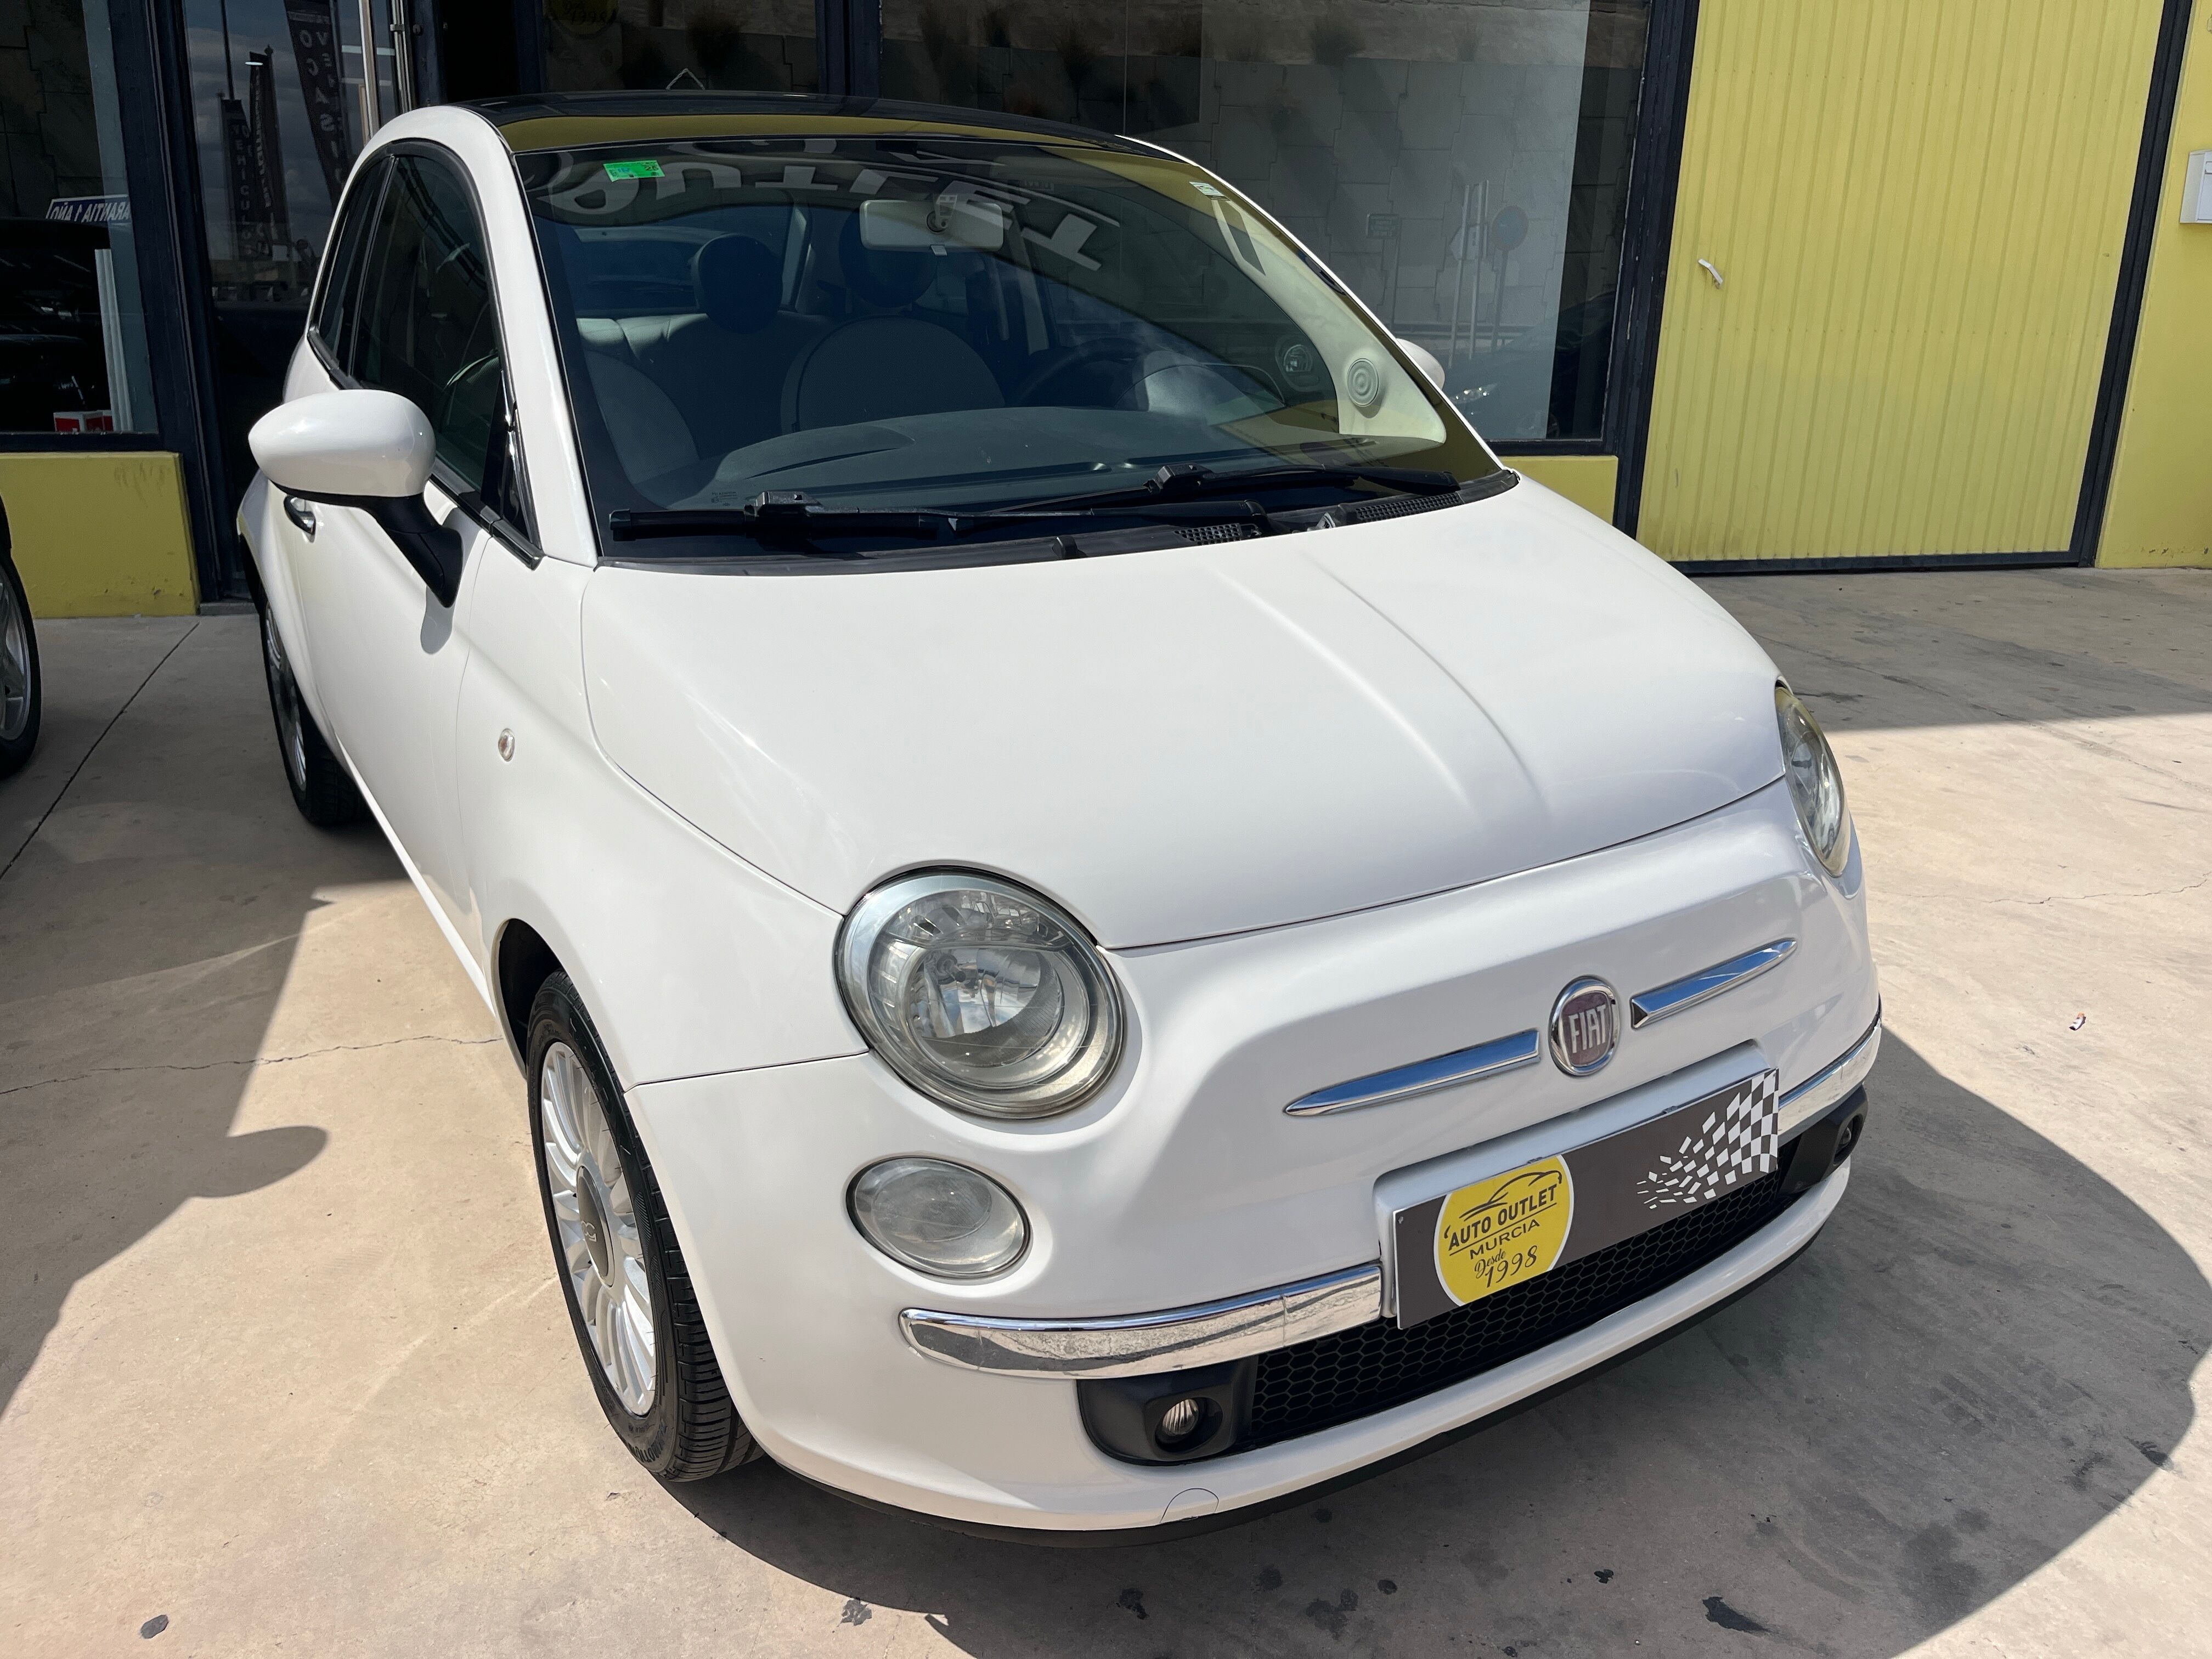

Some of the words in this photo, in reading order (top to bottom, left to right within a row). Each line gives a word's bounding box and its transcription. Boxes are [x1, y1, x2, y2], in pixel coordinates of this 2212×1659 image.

[1569, 1005, 1606, 1054] FIAT
[1498, 1184, 1557, 1226] OUTLET
[1470, 1219, 1540, 1260] MURCIA
[1474, 1248, 1506, 1279] Desde
[1485, 1245, 1537, 1288] 1998
